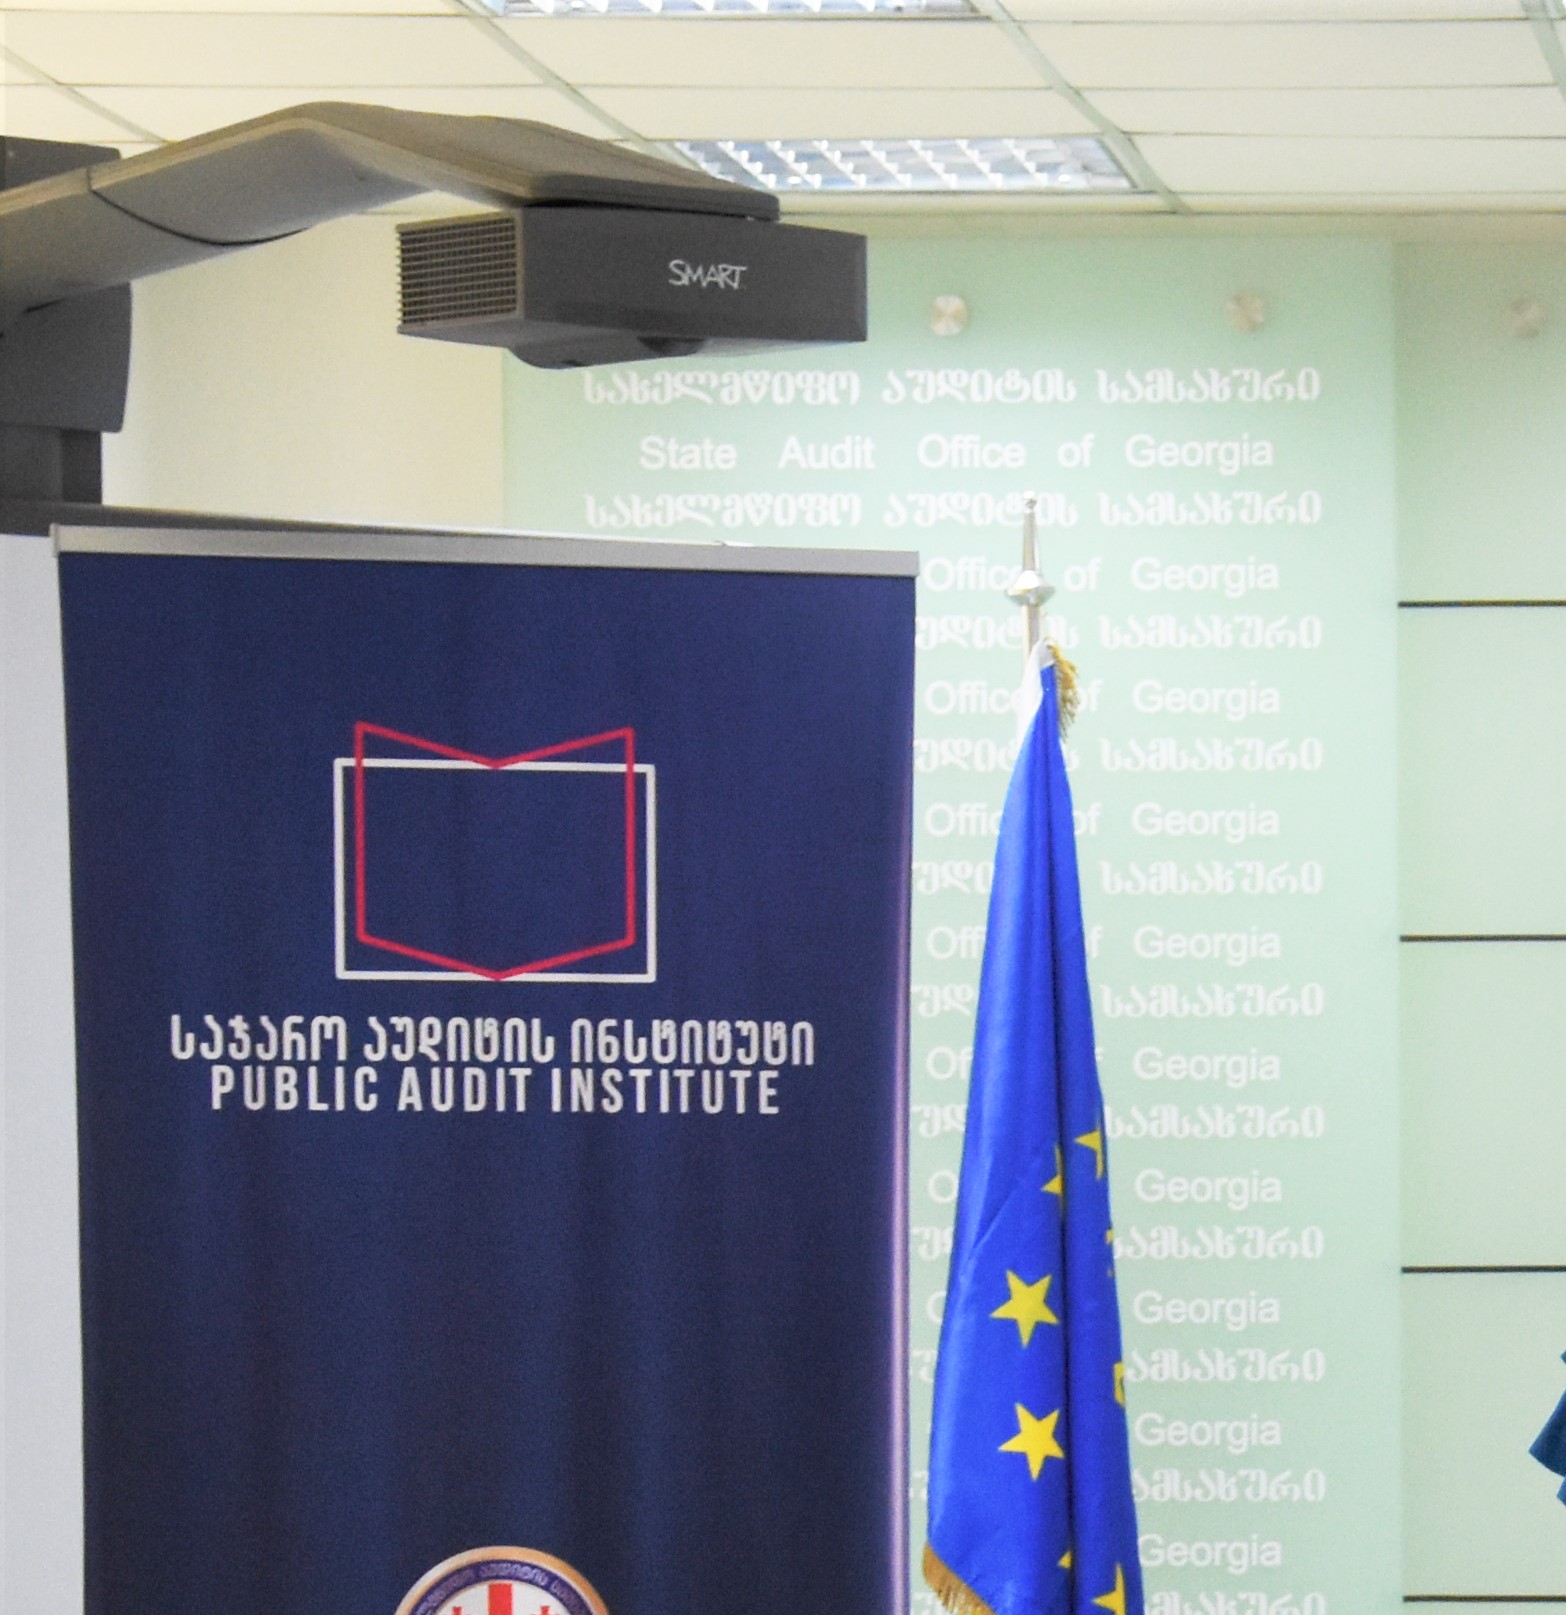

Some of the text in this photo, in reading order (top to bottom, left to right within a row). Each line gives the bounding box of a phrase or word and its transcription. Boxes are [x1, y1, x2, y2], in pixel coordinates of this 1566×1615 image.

[668, 259, 747, 289] SMART
[639, 432, 1274, 475] State Audit Office of Georgia
[1064, 556, 1102, 592] of
[1131, 555, 1280, 599] Georgia
[1132, 679, 1281, 722] Georgia
[924, 803, 1000, 837] Offic
[1131, 802, 1280, 844] Georgia
[1132, 926, 1281, 967] Georgia
[169, 1014, 816, 1068] საჯარო აუდიტის ინსტიტუტი
[1132, 1047, 1281, 1088] Georgia
[210, 1065, 781, 1115] PUBLIC AUDIT INSTITUTE
[1134, 1168, 1283, 1210] Georgia
[1132, 1291, 1281, 1331] Georgia
[1125, 1348, 1326, 1383] ამსახური
[1134, 1412, 1282, 1453] Georgia
[1138, 1534, 1282, 1574] Georgia
